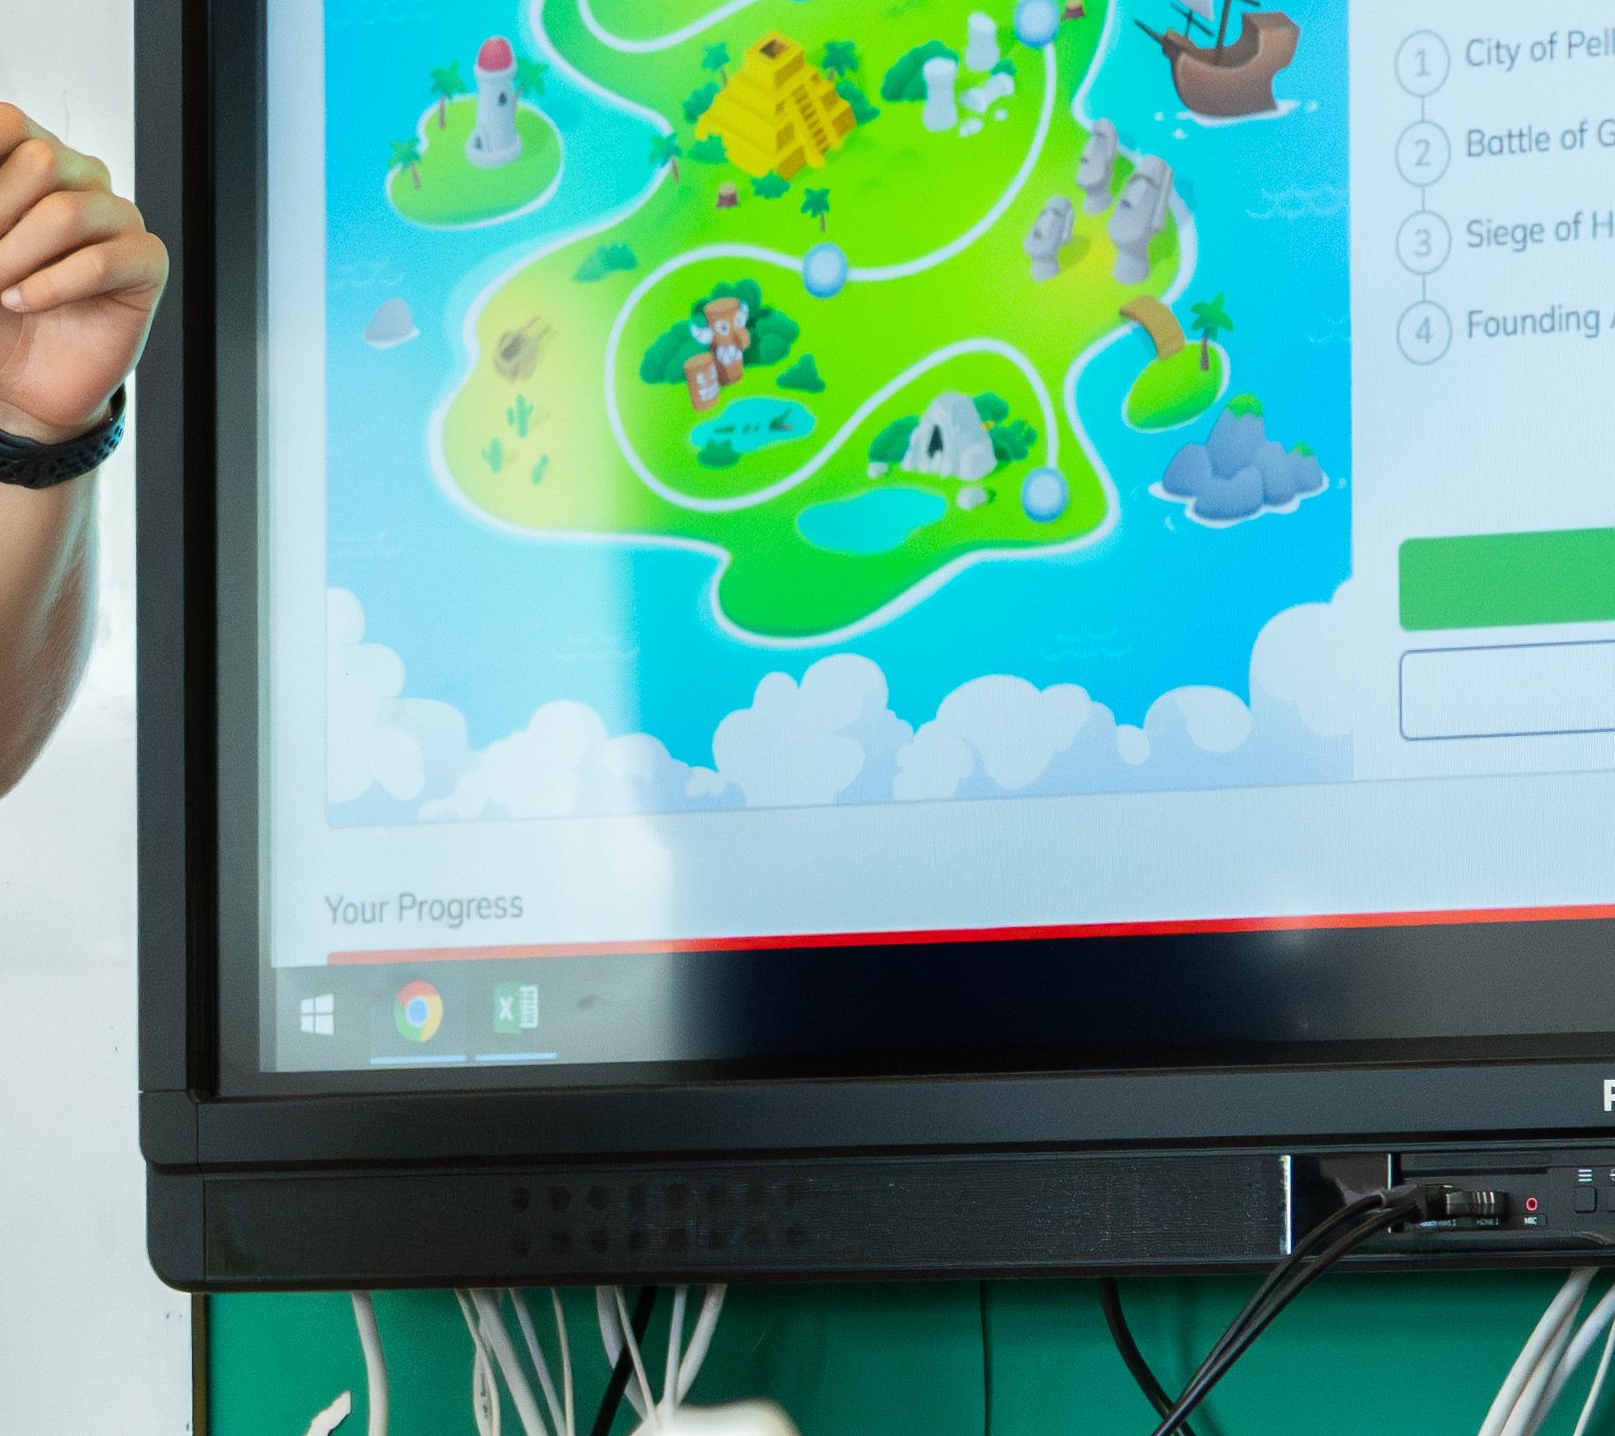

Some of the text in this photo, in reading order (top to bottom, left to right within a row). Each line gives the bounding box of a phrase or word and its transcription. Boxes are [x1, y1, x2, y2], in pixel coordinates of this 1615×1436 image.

[1414, 47, 1431, 78] 1
[1464, 37, 1522, 73] City
[1529, 30, 1559, 63] of
[1413, 137, 1432, 168] 2
[1465, 125, 1551, 159] Battle
[1559, 119, 1589, 151] of
[1413, 227, 1433, 259] 3
[1465, 218, 1546, 254] Siege
[1553, 210, 1583, 243] of
[1414, 315, 1433, 345] 4
[1466, 304, 1601, 340] Founding
[324, 891, 524, 931] Your Progress
